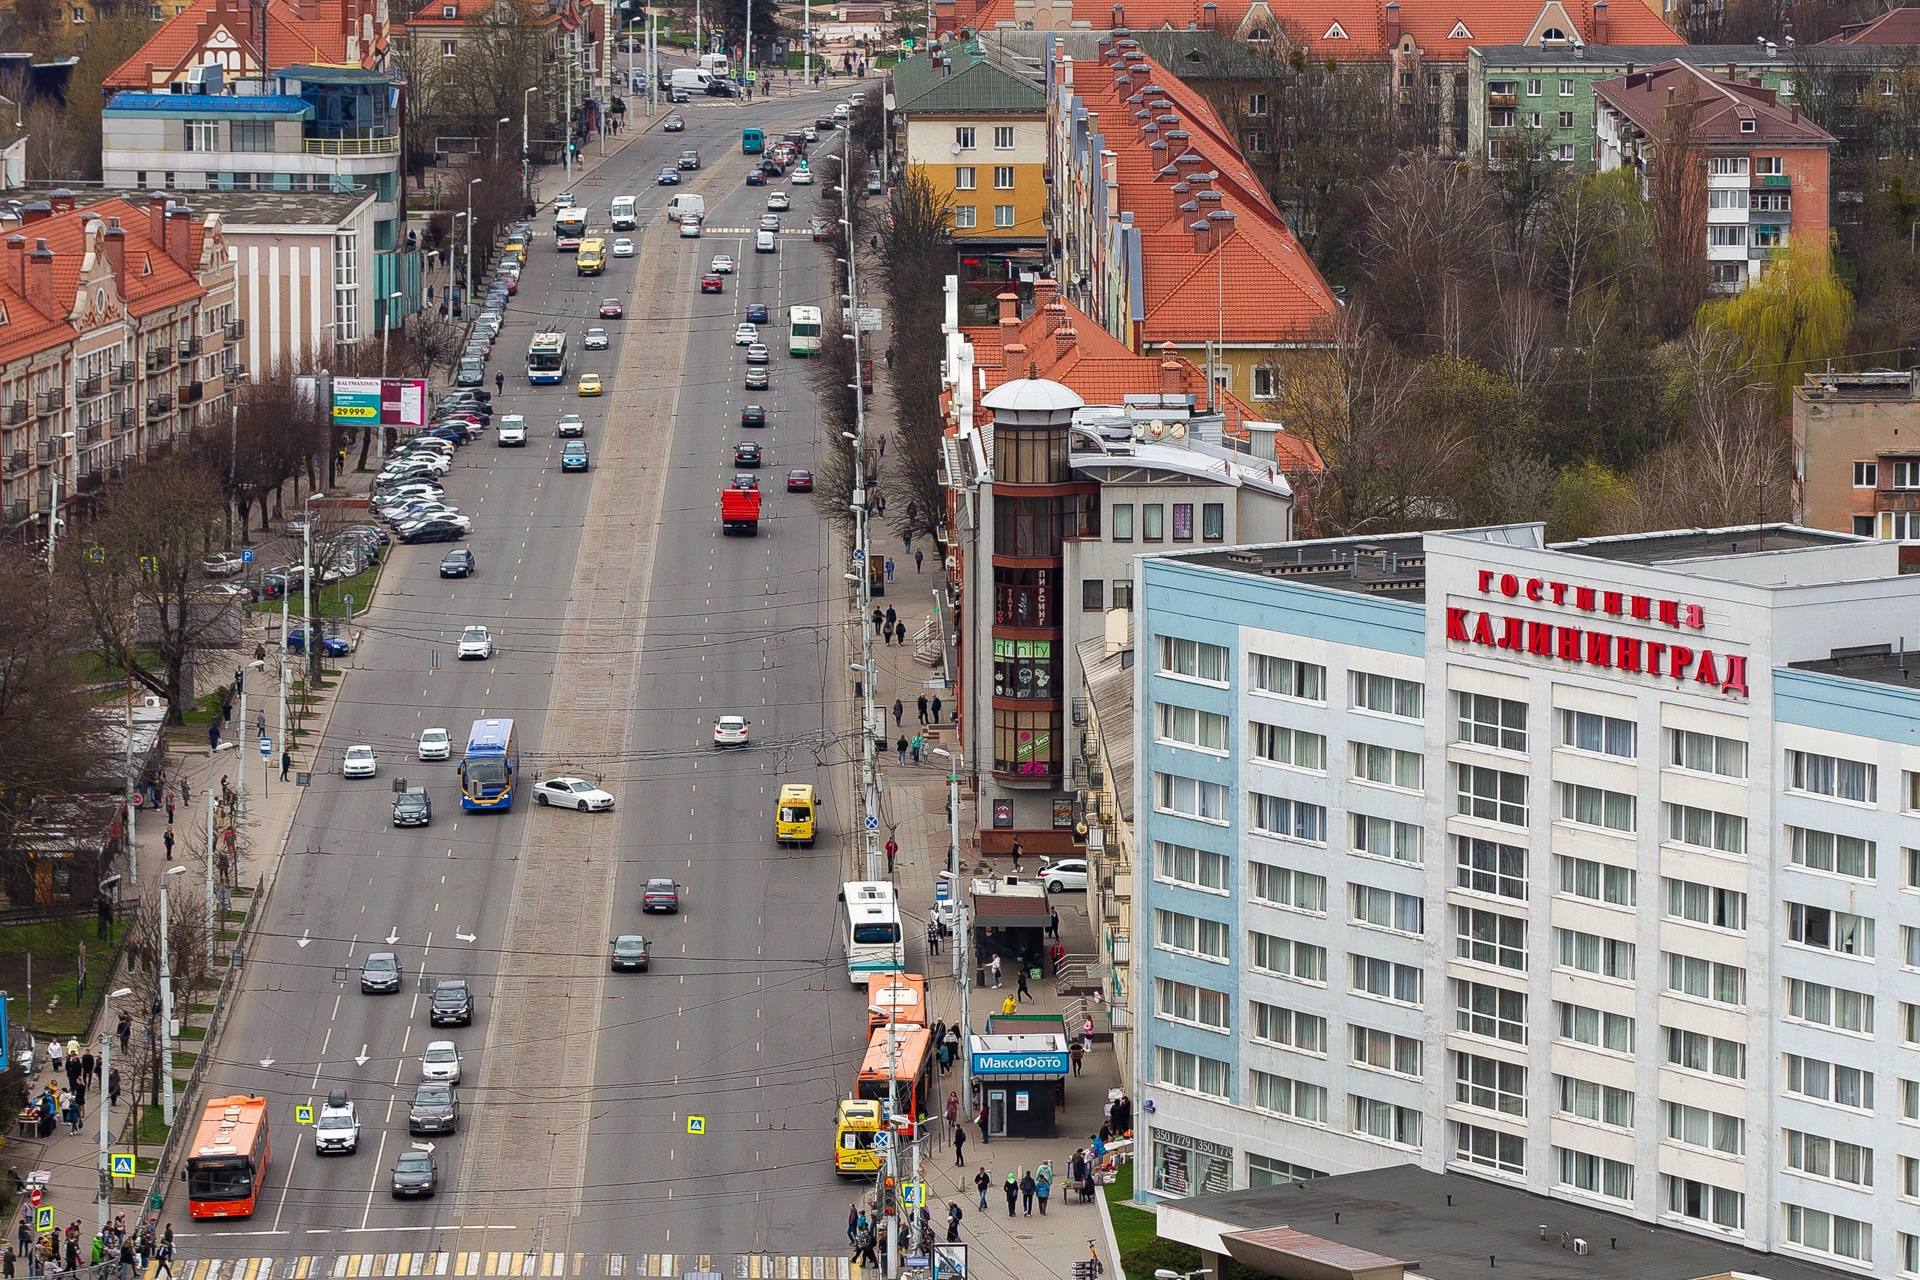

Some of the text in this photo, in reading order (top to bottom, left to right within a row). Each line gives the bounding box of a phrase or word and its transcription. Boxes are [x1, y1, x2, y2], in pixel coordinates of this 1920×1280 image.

[244, 552, 251, 560] P
[1446, 606, 1748, 698] КАЛИНИНГРАД
[1018, 736, 1049, 754] Нуга Бест
[980, 1057, 1061, 1068] МаксиФото
[1155, 1129, 1170, 1141] 350
[1176, 1134, 1190, 1146] 779
[1198, 1141, 1213, 1152] 350
